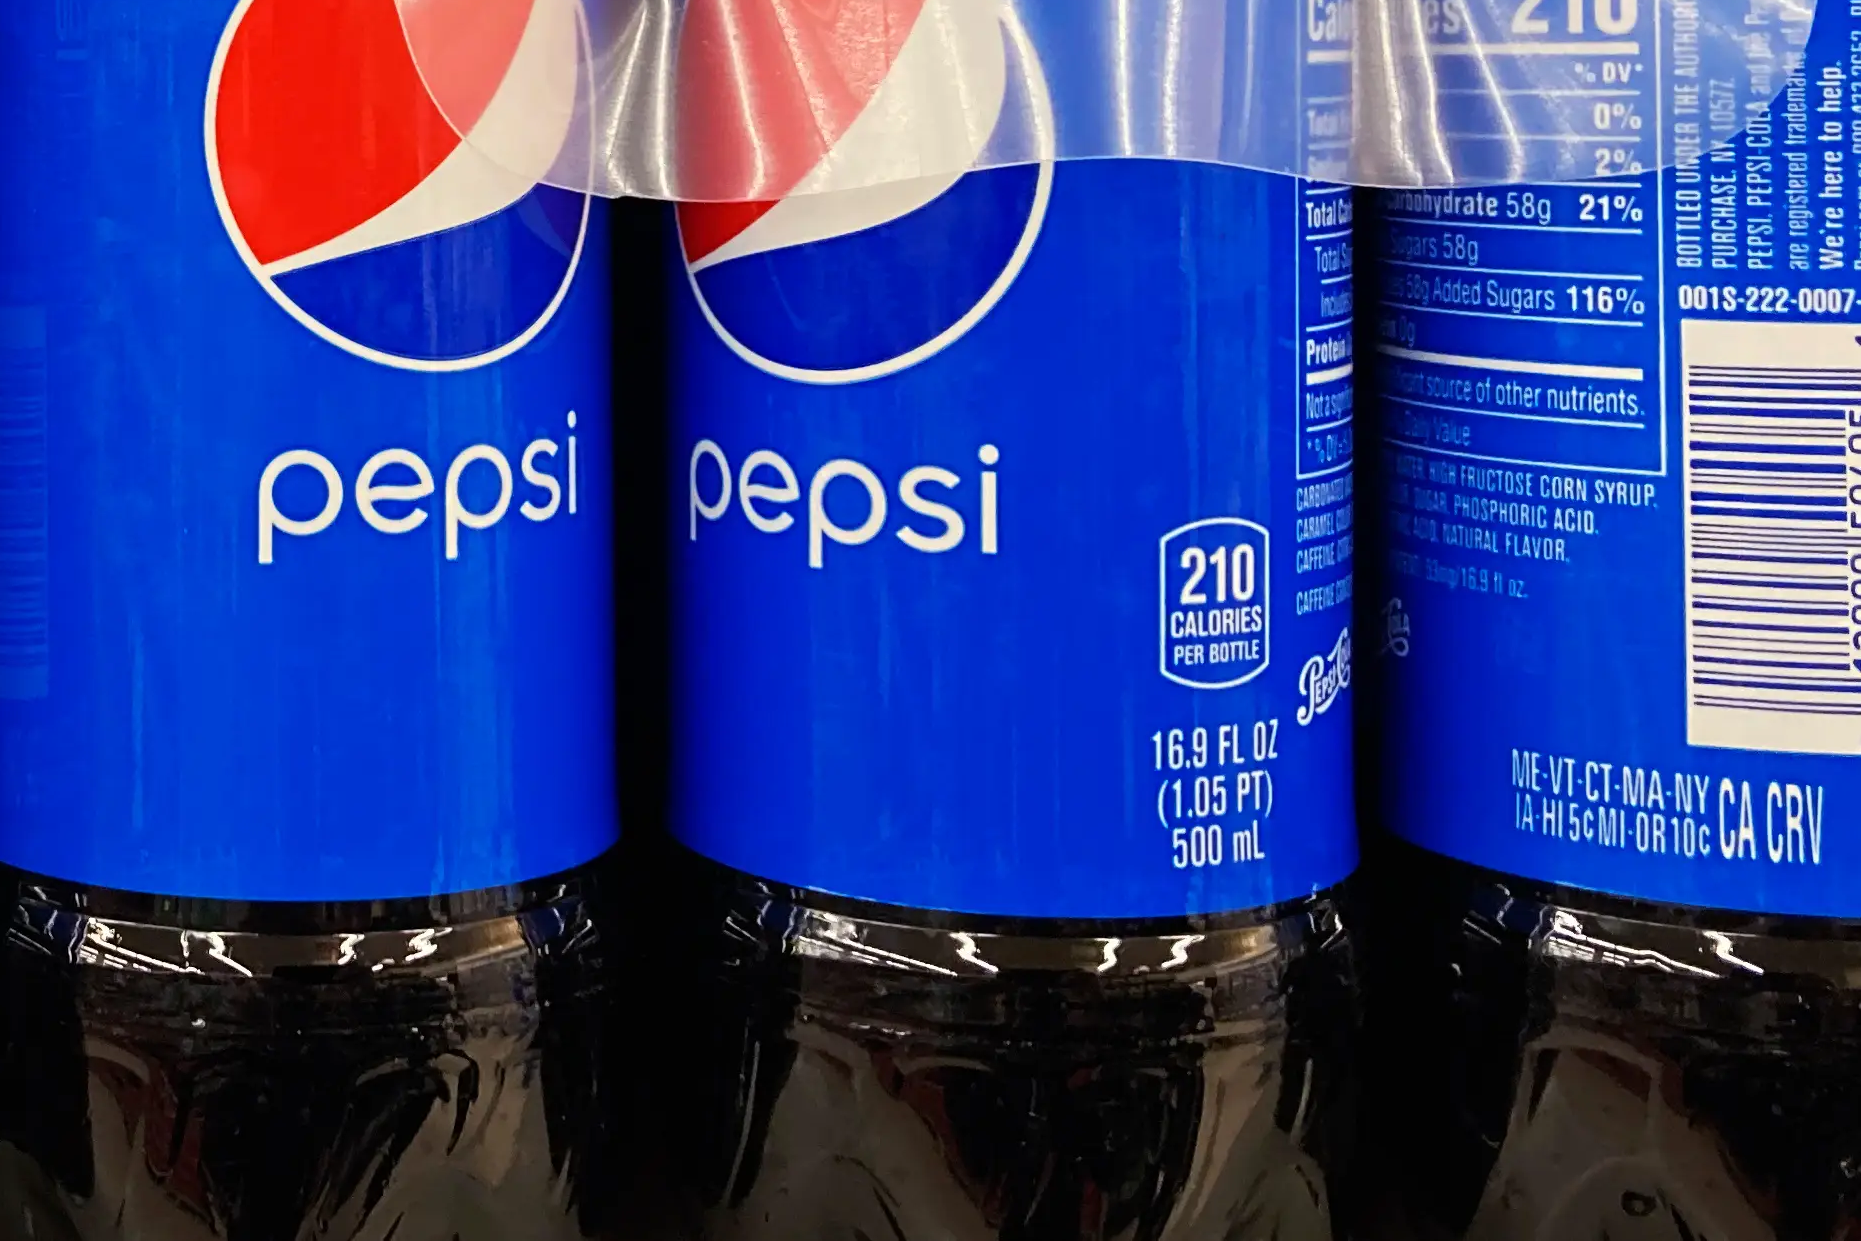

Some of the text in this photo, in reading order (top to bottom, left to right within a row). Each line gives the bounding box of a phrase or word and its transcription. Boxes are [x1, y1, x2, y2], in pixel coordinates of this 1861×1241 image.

[1745, 64, 1771, 94] and
[1781, 50, 1808, 145] trademarks
[1594, 102, 1642, 130] 0%
[1673, 83, 1700, 115] THE
[1594, 147, 1643, 176] 2%
[1674, 122, 1701, 183] UNDER
[1710, 138, 1737, 163] NY
[1745, 100, 1773, 206] PEPSI-COLA
[1816, 60, 1847, 270] We're here to help.
[1506, 191, 1644, 225] 58g 21%
[1781, 152, 1814, 236] registered
[1676, 189, 1702, 269] BOTTLED
[1441, 233, 1479, 266] 58g
[1788, 242, 1810, 270] are
[1432, 278, 1482, 307] Added
[1486, 279, 1556, 315] Sugars
[1566, 284, 1646, 315] 116%
[1475, 376, 1646, 416] of other nutrients.
[259, 410, 578, 564] pepsi
[1460, 464, 1534, 497] FRUCTOSE
[1540, 474, 1587, 502] CORN
[690, 438, 1000, 568] pepsi
[1454, 493, 1548, 529] PHOSPHORIC
[1442, 522, 1499, 554] NATURAL
[1179, 543, 1256, 606] 210
[1170, 605, 1263, 640] CALORIES
[1173, 638, 1260, 666] PER BOTTLE
[1151, 718, 1280, 772] 16.9 FL OZ
[1157, 769, 1273, 828] (1.05 PT)
[1718, 777, 1758, 860] CA
[1766, 780, 1824, 865] CRV
[1171, 819, 1266, 869] 500 mL
